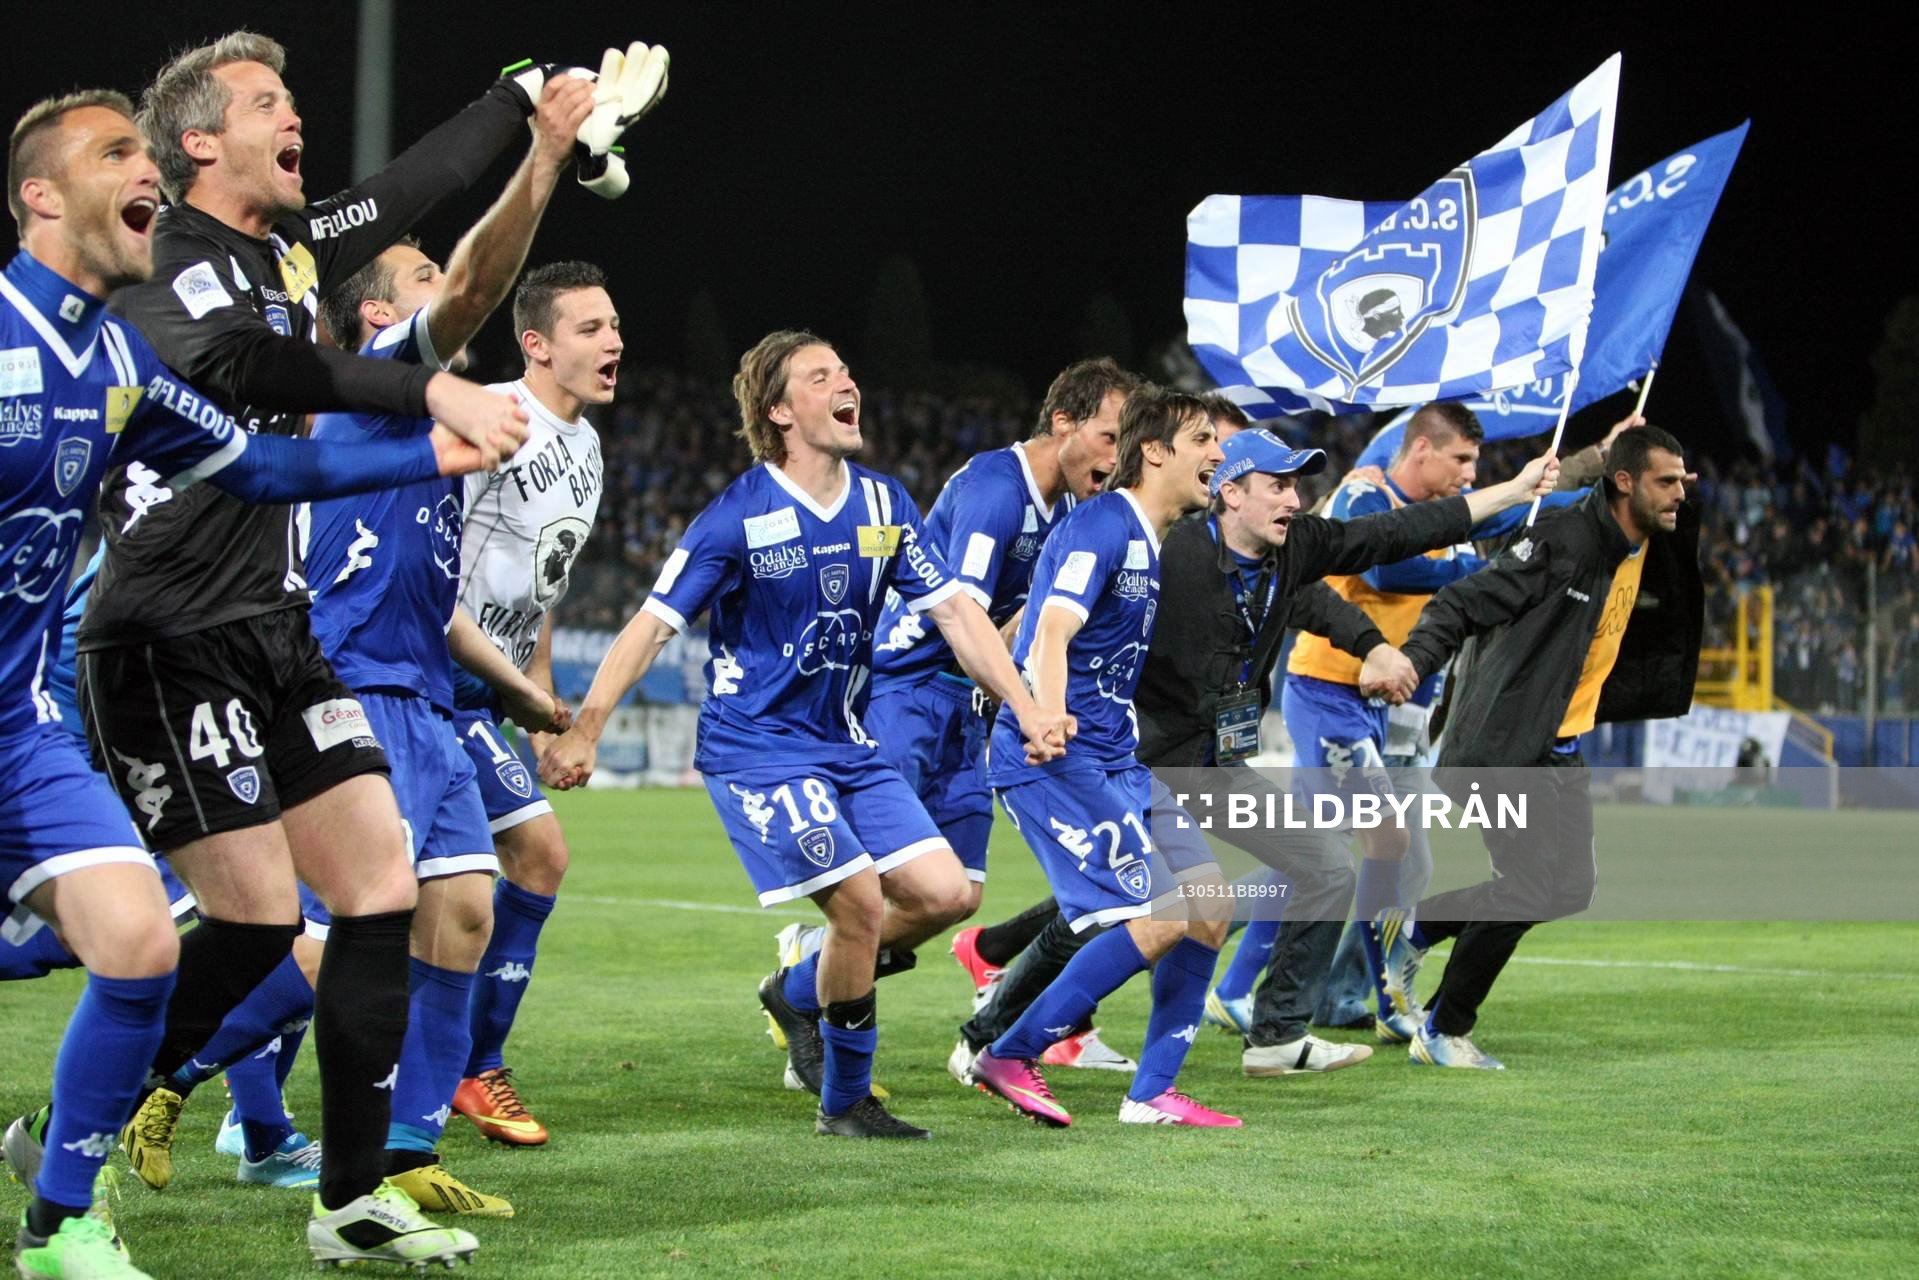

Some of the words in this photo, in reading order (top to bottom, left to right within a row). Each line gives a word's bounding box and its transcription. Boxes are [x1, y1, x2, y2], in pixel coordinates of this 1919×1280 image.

[53, 406, 99, 423] Kappa
[512, 434, 575, 502] FORZA
[750, 544, 806, 571] Odalys
[752, 554, 807, 574] vacances
[812, 542, 851, 556] Kappa
[189, 698, 265, 769] 40
[771, 778, 837, 834] 18
[1086, 811, 1155, 870] 21
